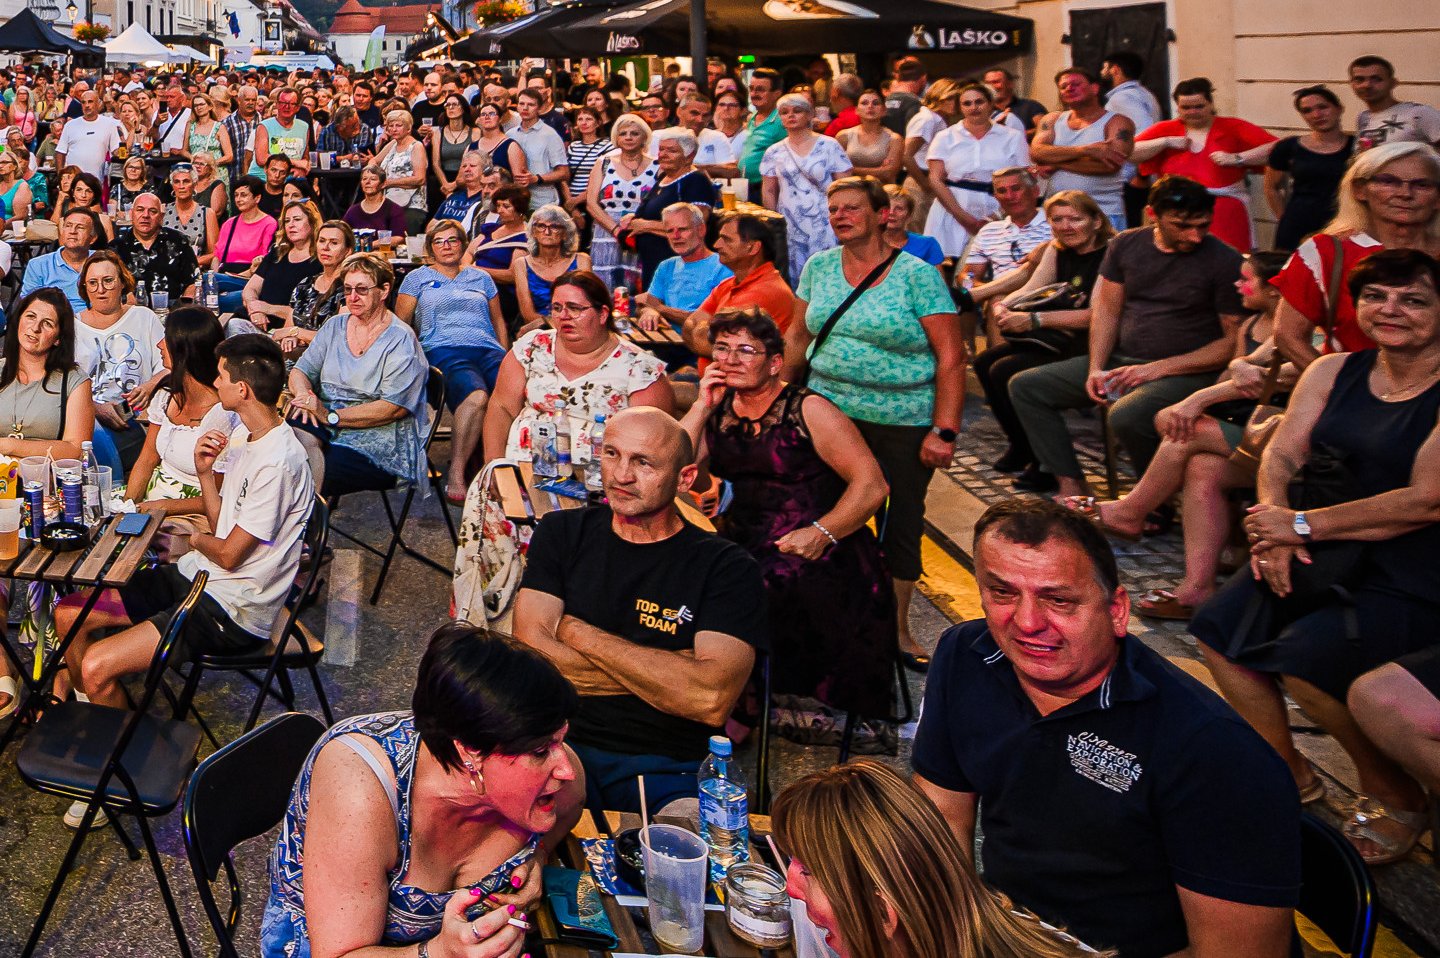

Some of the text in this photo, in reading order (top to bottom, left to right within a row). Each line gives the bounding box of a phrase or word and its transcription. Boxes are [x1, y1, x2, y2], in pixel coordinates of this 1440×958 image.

[636, 599, 660, 614] TOP
[640, 613, 677, 635] FOAM
[1066, 743, 1141, 782] EXPLORATION
[1067, 734, 1133, 768] NAVIGATION
[1132, 763, 1143, 774] &
